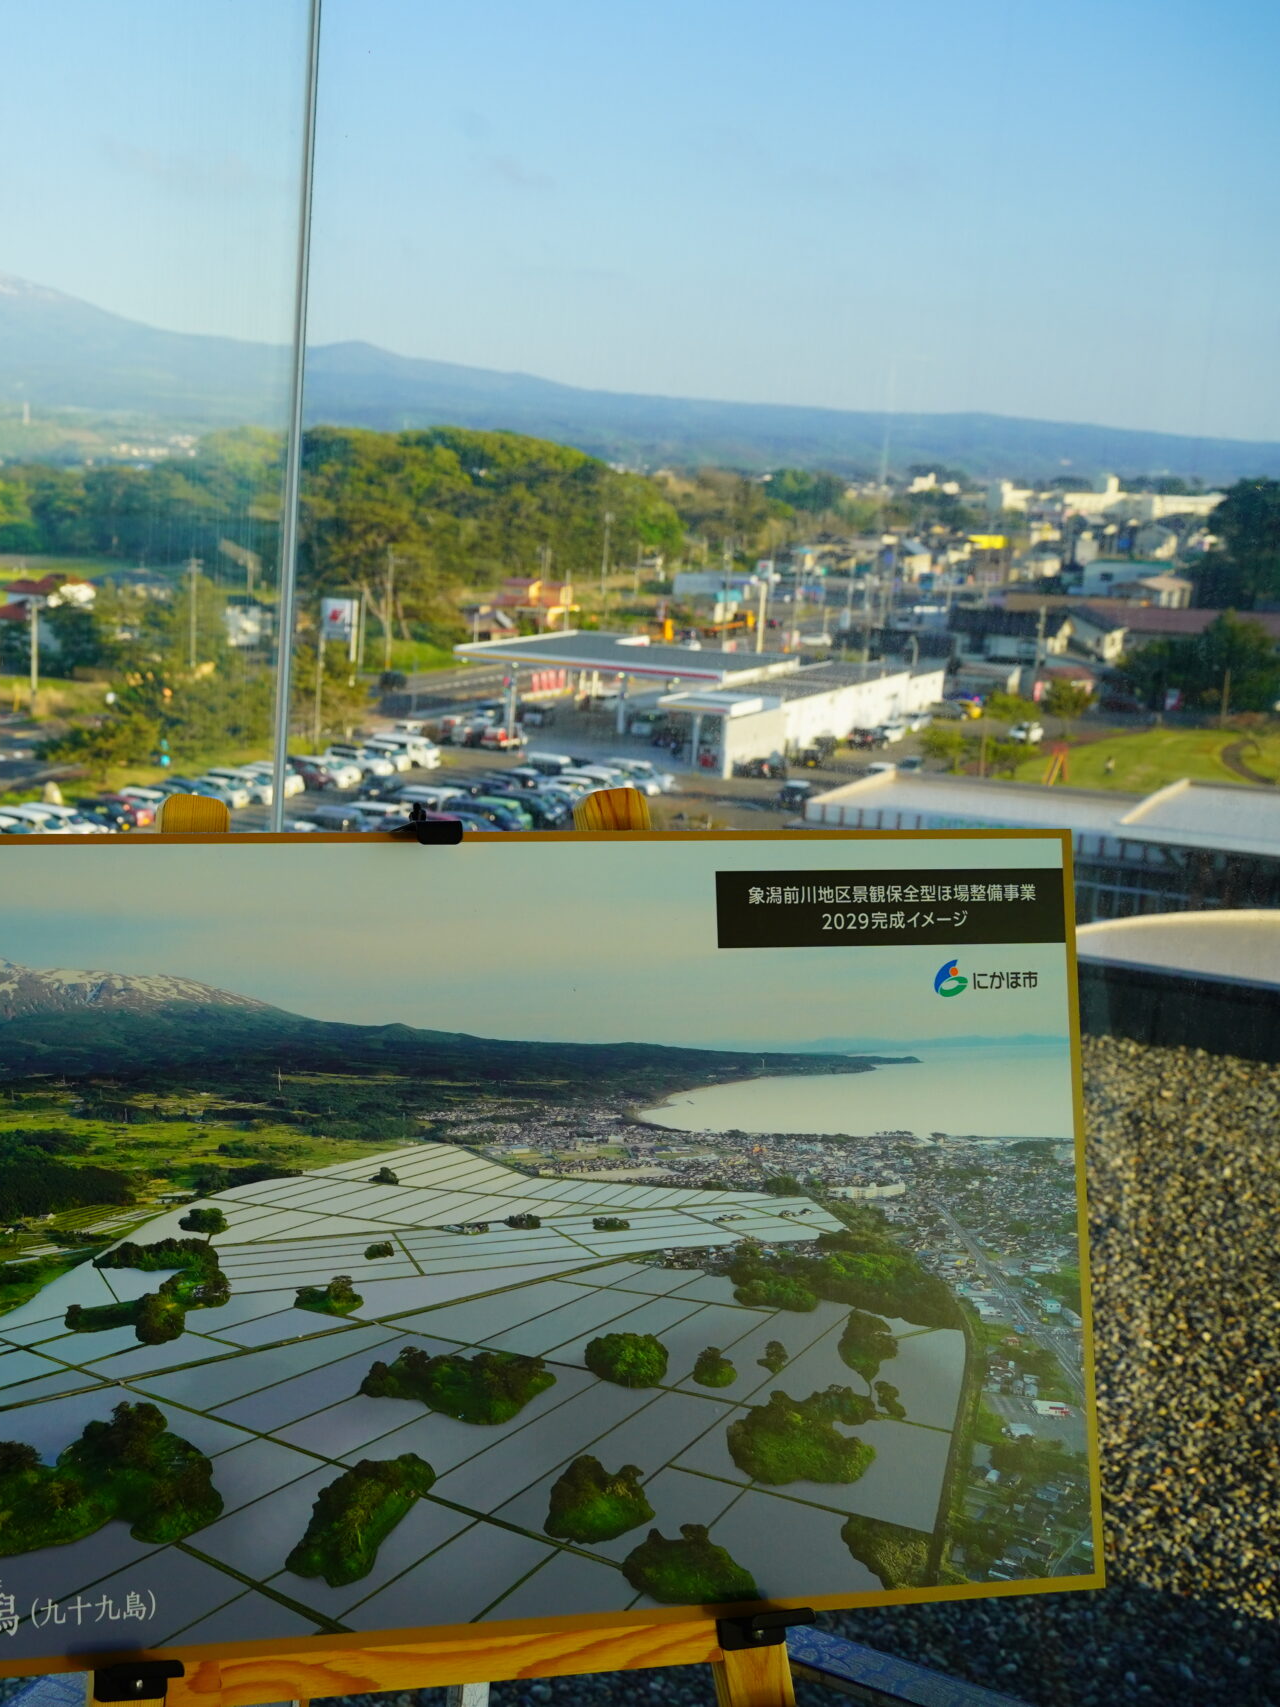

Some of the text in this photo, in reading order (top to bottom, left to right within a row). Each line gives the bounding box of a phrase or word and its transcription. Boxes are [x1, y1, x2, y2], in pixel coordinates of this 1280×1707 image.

[748, 884, 1037, 904] 象潟前川地区景観保全型ほ場整備事業
[821, 910, 969, 930] 2029完成イメージ
[973, 971, 1039, 990] にかほ市
[31, 1589, 157, 1629] (九十九島)
